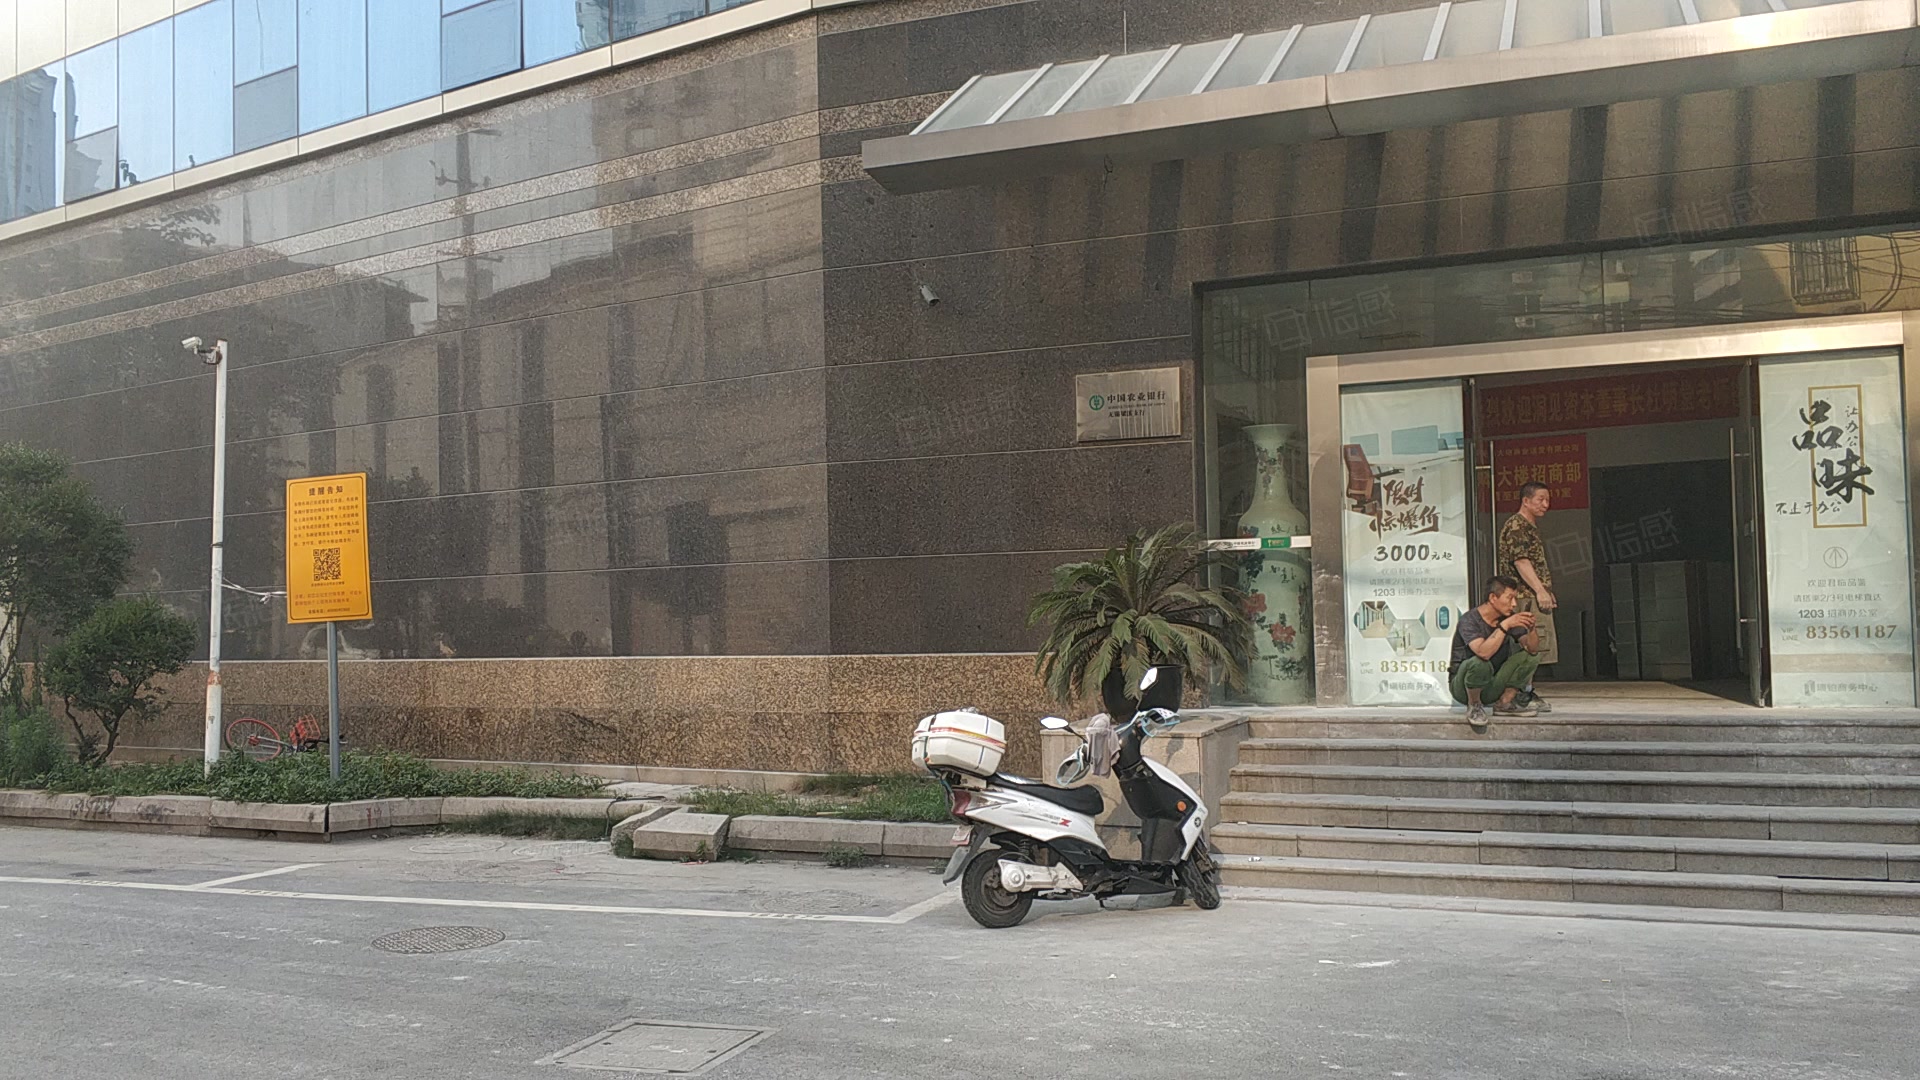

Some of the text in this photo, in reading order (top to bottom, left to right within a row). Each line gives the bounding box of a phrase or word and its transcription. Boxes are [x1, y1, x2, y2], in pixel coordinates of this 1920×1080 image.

[1107, 390, 1166, 404] 中国农业银行
[1845, 405, 1859, 447] 让办公
[1792, 400, 1875, 503] 品味
[308, 485, 344, 496] 提醒告知
[1383, 476, 1424, 507] 限时
[1369, 504, 1441, 542] 惊爆价
[1373, 588, 1396, 597] 1203
[1798, 609, 1825, 619] 1203
[1806, 624, 1897, 640] 83561187
[1380, 660, 1447, 673] 8356118
